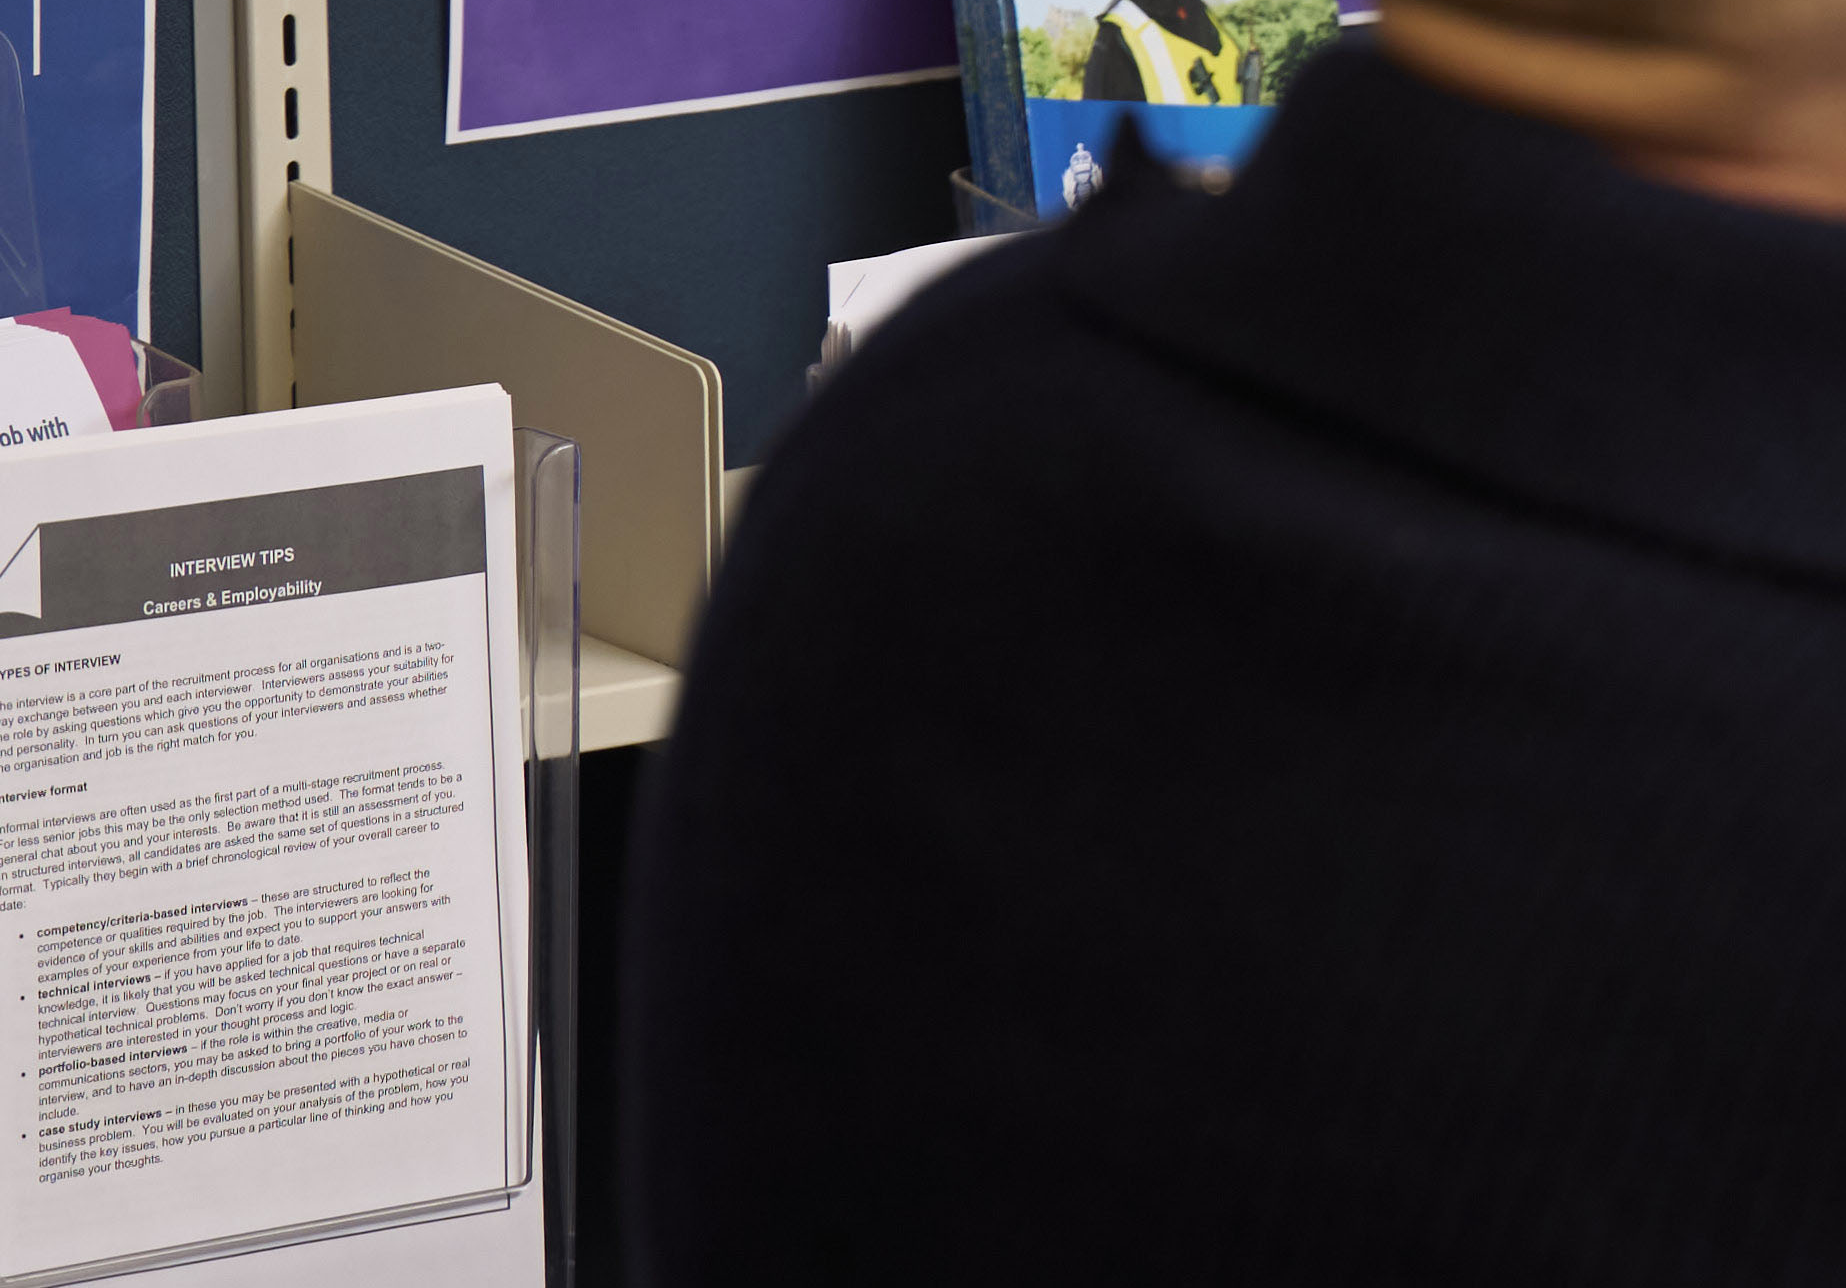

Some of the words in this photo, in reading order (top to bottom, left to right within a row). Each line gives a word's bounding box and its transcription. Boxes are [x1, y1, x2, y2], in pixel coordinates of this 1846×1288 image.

[0, 428, 23, 446] ob
[29, 416, 69, 441] with
[170, 552, 255, 577] INTERVIEW
[260, 547, 294, 564] TIPS
[143, 598, 201, 615] Careers
[206, 592, 216, 607] &
[221, 579, 322, 605] Employability
[0, 666, 30, 680] YPES
[34, 663, 49, 675] OF
[54, 654, 120, 673] INTERVIEW
[15, 695, 64, 709] interview
[65, 692, 76, 702] is
[78, 692, 86, 701] a
[87, 688, 112, 699] core
[114, 683, 136, 698] part
[137, 680, 150, 693] of
[150, 679, 169, 691] the
[170, 669, 231, 688] recruitment
[232, 665, 276, 682] process
[277, 661, 292, 673] for
[294, 658, 307, 671] all
[309, 651, 380, 670] organisations
[381, 645, 402, 659] and
[403, 644, 413, 655] is
[414, 644, 422, 654] a
[11, 728, 34, 741] role
[35, 725, 50, 739] by
[51, 721, 87, 735] asking
[89, 714, 142, 732] questions
[143, 708, 175, 722] which
[176, 705, 200, 720] give
[201, 703, 222, 717] you
[223, 699, 242, 711] the
[243, 691, 303, 710] opportunity
[304, 689, 316, 700] to
[317, 679, 384, 698] demonstrate
[385, 676, 409, 691] your
[410, 671, 449, 684] abilities
[16, 709, 70, 725] exchange
[71, 702, 118, 717] between
[120, 699, 141, 713] you
[142, 693, 163, 707] and
[165, 690, 193, 704] each
[260, 673, 325, 690] Interviewers
[327, 668, 365, 681] assess
[366, 664, 391, 678] your
[392, 656, 439, 672] suitability
[440, 653, 454, 664] for
[84, 735, 95, 746] In
[97, 733, 119, 744] turn
[120, 729, 142, 743] you
[143, 726, 164, 737] can
[165, 721, 185, 734] ask
[187, 716, 239, 733] questions
[240, 711, 252, 724] of
[254, 710, 279, 725] your
[280, 701, 344, 718] interviewers
[346, 696, 367, 709] and
[368, 692, 405, 706] assess
[406, 685, 447, 700] whether
[12, 753, 80, 773] organisation
[81, 748, 103, 762] and
[104, 746, 122, 761] job
[124, 744, 134, 755] is
[135, 742, 154, 754] the
[155, 737, 180, 753] right
[182, 733, 215, 747] match
[216, 730, 232, 742] for
[0, 789, 47, 804] nterview
[49, 781, 87, 796] format
[35, 906, 188, 938] competency/criteria-based
[190, 898, 249, 915] interviews
[37, 981, 90, 1000] technical
[92, 974, 151, 991] interviews
[37, 1052, 126, 1079] portfolio-based
[128, 1045, 188, 1062] interviews
[37, 1125, 66, 1138] case
[67, 1118, 101, 1133] study
[102, 1109, 162, 1127] interviews
